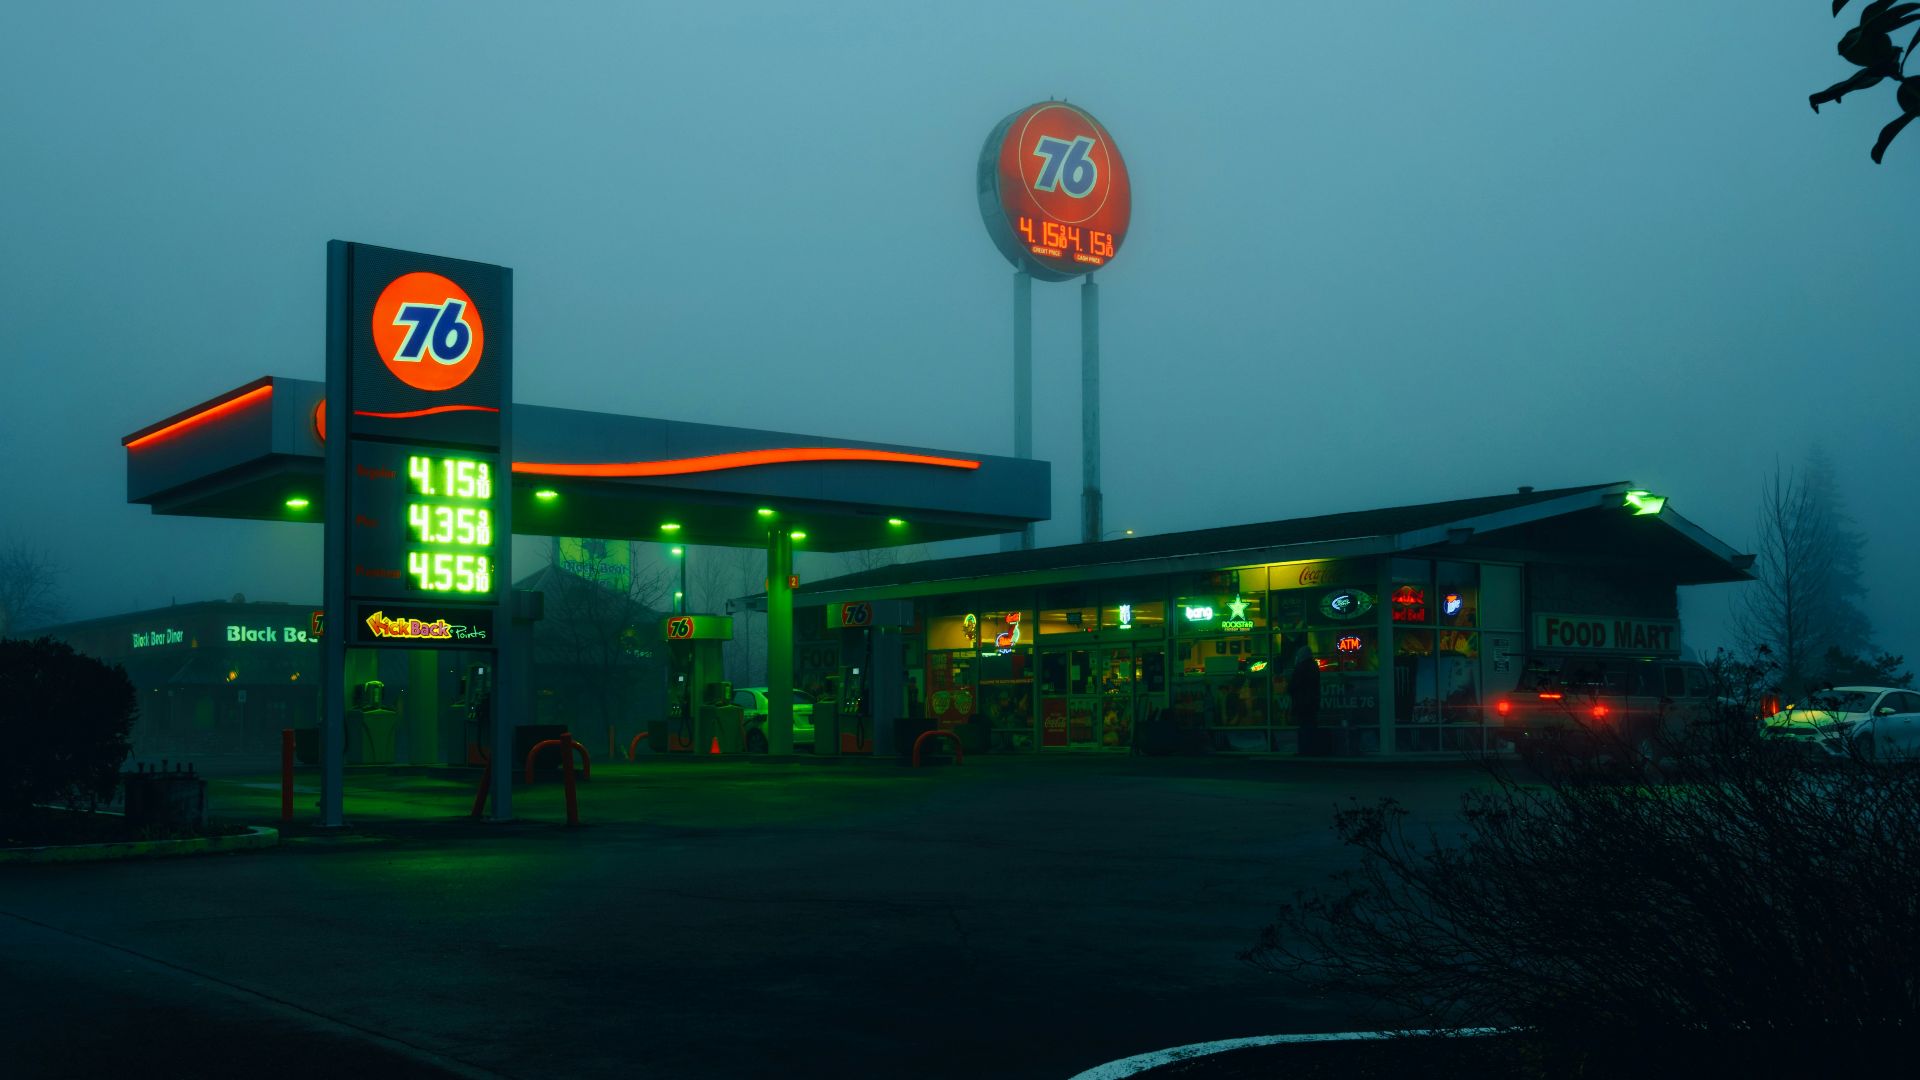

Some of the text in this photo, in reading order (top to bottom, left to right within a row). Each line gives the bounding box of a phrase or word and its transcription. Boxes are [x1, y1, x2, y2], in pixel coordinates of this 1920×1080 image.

[1033, 135, 1097, 198] 76
[392, 298, 472, 365] 76
[410, 504, 475, 544] 4.35
[409, 552, 475, 592] 4.55
[791, 577, 796, 586] 2
[845, 604, 867, 625] 76
[227, 626, 318, 643] Black Be
[671, 618, 689, 637] 76
[1546, 618, 1674, 649] FOOD MART
[133, 628, 183, 648] Black Bear Diner
[1340, 637, 1359, 650] ATM
[800, 647, 836, 669] FOO
[1320, 684, 1345, 696] UTH
[1359, 696, 1375, 709] 76
